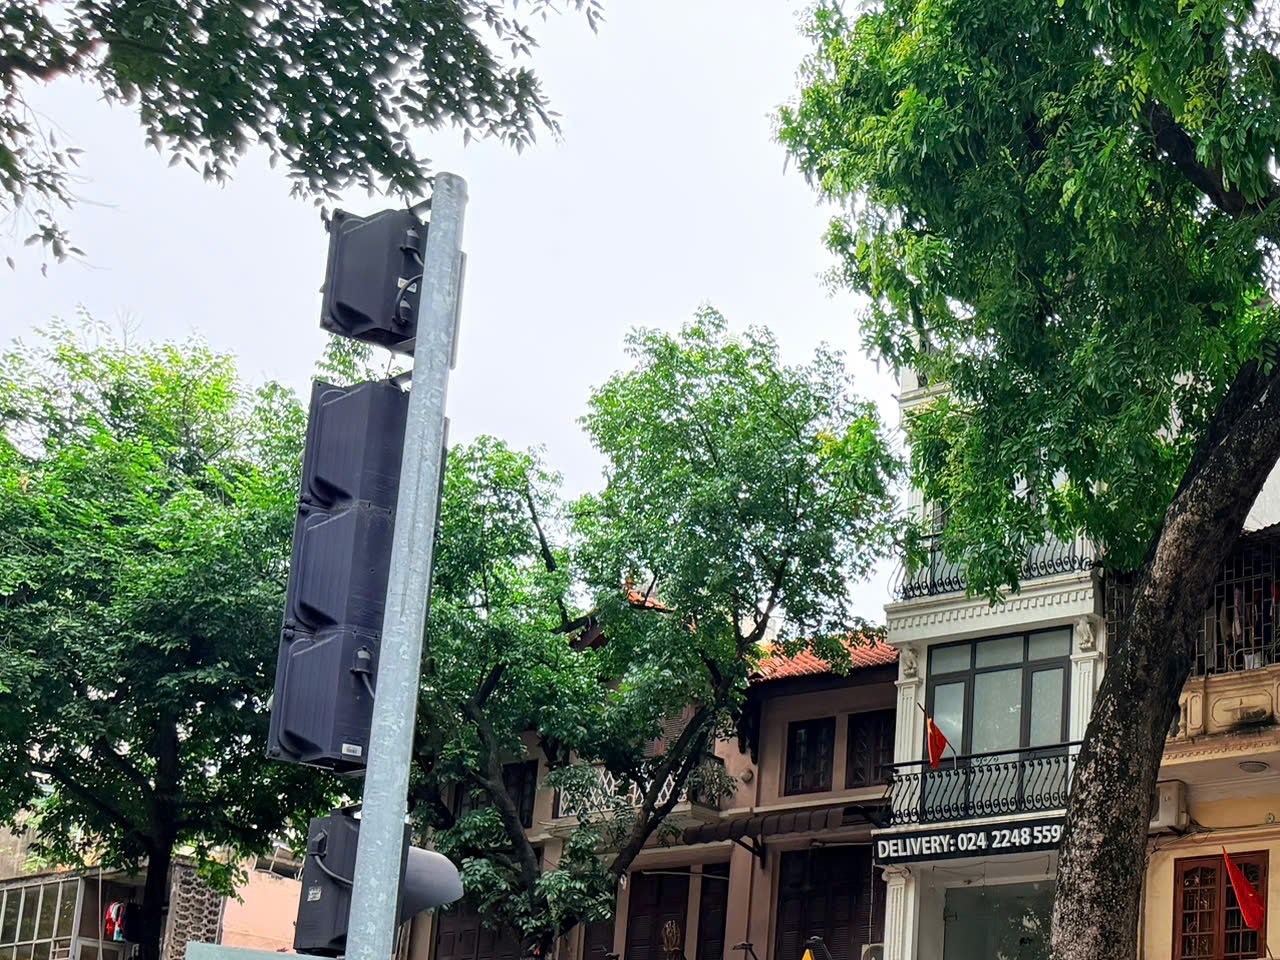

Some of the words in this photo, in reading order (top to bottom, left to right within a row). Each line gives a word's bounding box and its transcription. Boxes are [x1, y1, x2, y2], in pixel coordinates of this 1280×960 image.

[878, 834, 955, 858] DELIVERY:
[958, 832, 988, 851] 024
[991, 828, 1031, 848] 2248
